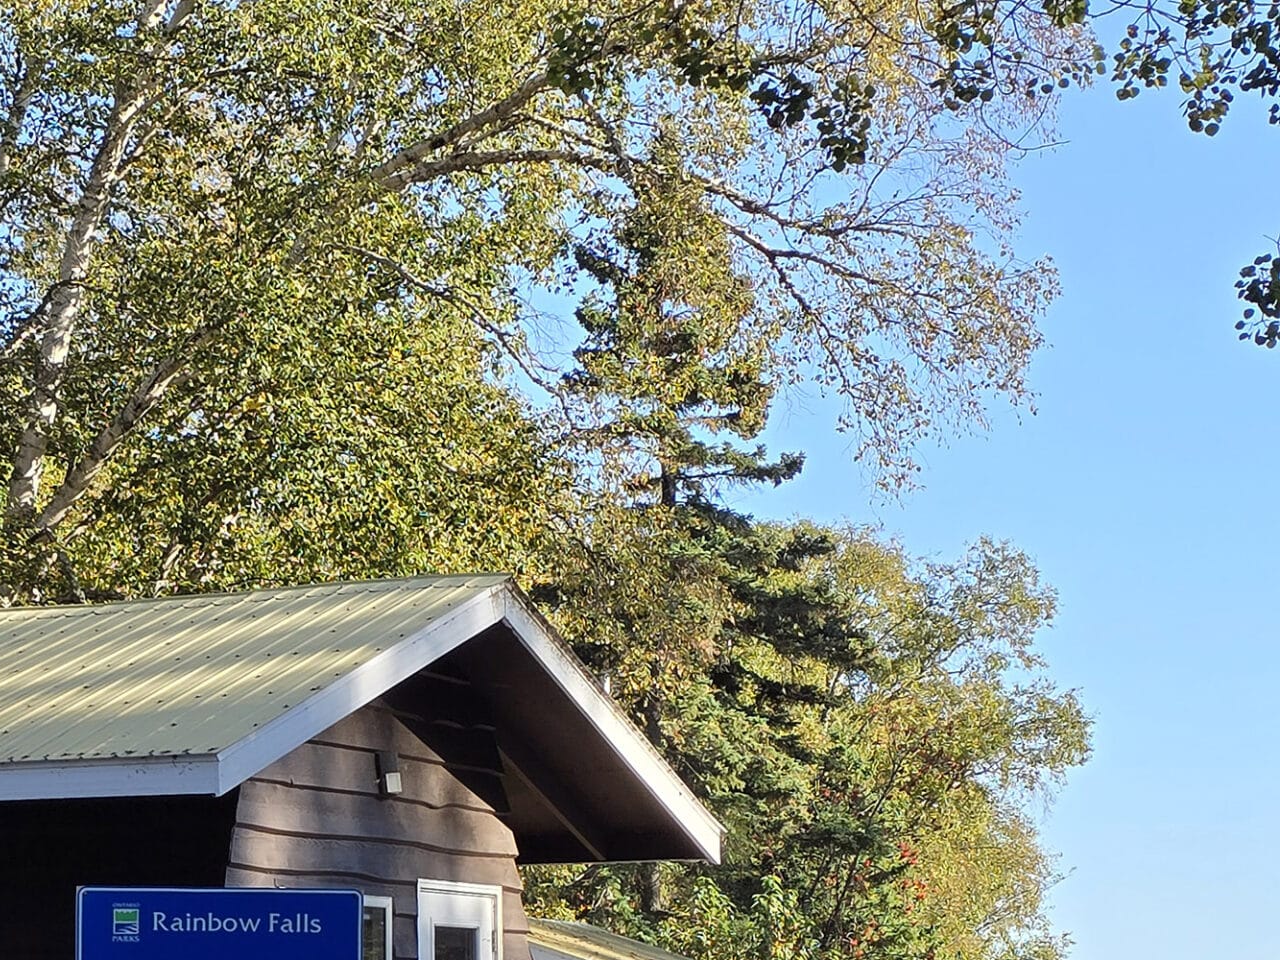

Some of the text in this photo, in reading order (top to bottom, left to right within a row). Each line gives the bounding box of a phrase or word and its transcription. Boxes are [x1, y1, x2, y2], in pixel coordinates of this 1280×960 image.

[152, 911, 322, 934] Rainbow Falls
[111, 935, 141, 943] PARKS
